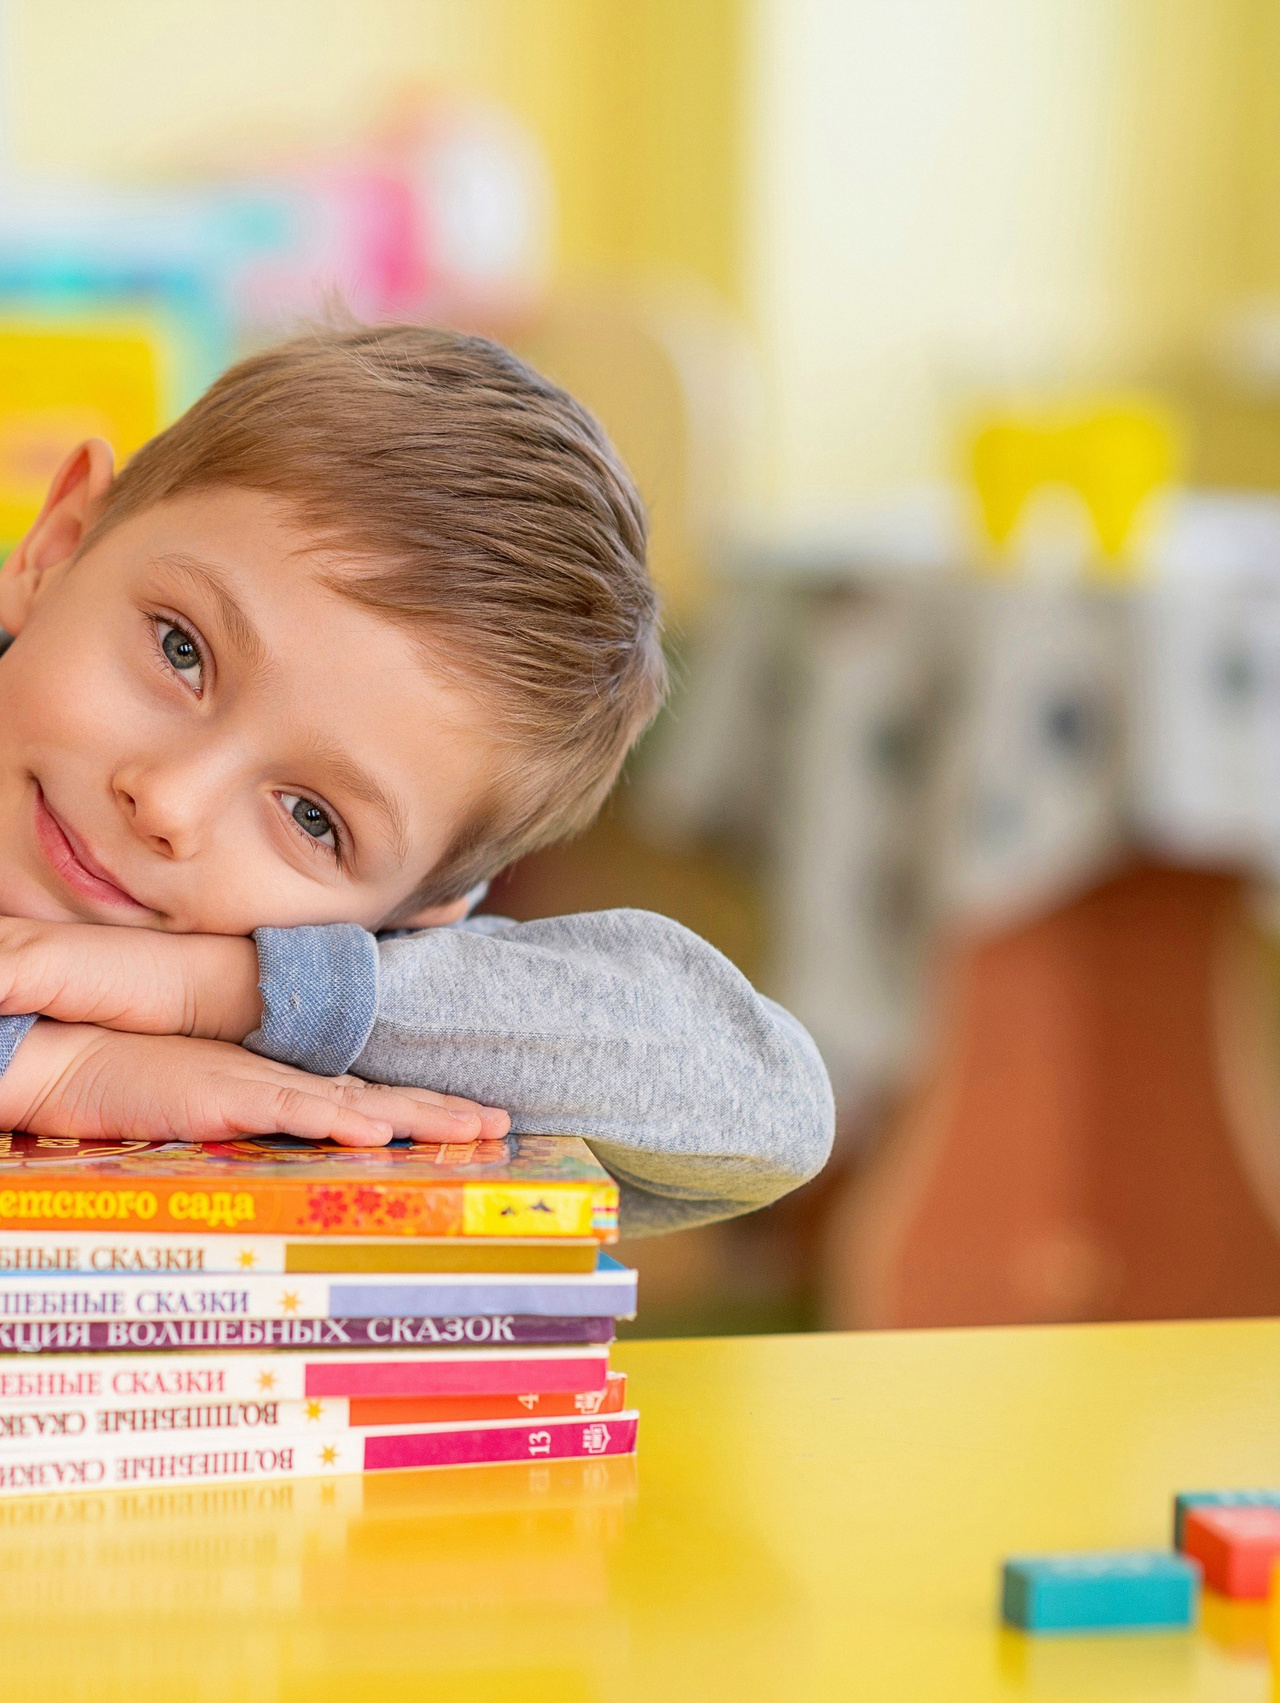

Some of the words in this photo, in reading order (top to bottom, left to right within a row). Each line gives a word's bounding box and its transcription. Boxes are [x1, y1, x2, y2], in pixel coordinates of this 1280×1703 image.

[168, 1190, 255, 1228] сада
[91, 1245, 207, 1271] СКАЗКИ
[136, 1290, 250, 1315] СКАЗКИ
[107, 1319, 352, 1347] ВОЛШЕБНЫХ
[366, 1315, 516, 1343] СКАЗОК
[112, 1369, 226, 1395] СКАЗКИ
[97, 1402, 280, 1434] ВОЛШЕБНЫЕ
[528, 1430, 552, 1456] 13
[116, 1448, 294, 1482] ВОЛШЕБНЫЕ
